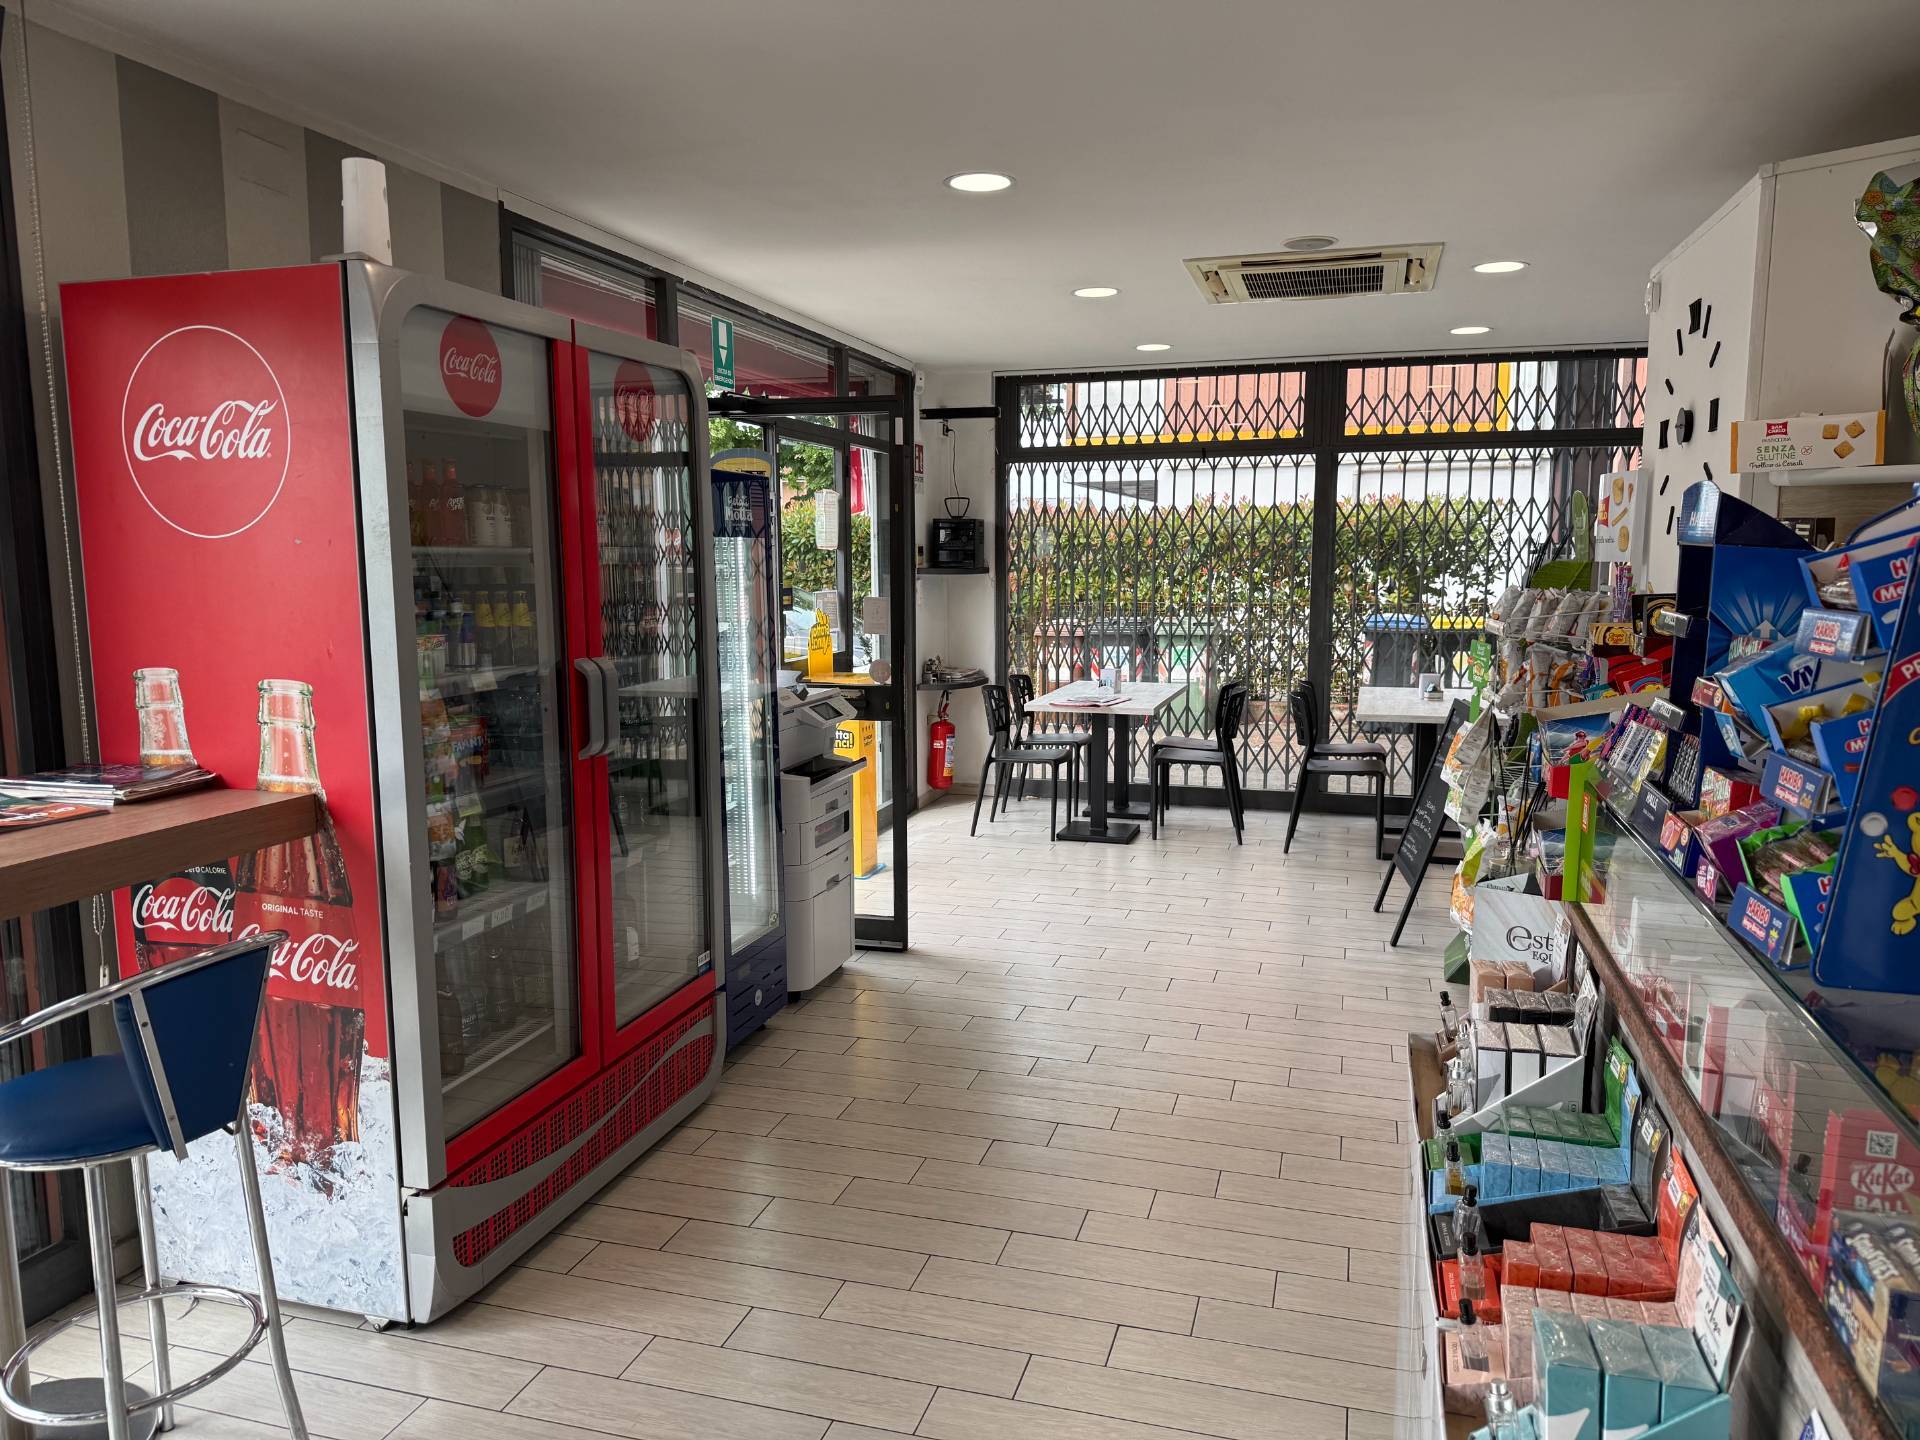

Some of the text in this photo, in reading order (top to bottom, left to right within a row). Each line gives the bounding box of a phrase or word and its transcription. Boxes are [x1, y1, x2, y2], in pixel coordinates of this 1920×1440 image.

[444, 347, 498, 384] Coca-Cola
[133, 399, 278, 462] Coca-Cola
[1756, 444, 1796, 454] SENZA
[1756, 452, 1796, 462] GLUTINE
[1779, 764, 1804, 793] HARIBO
[200, 866, 227, 875] CALORIE
[132, 884, 236, 933] Coca-Cola
[261, 902, 324, 919] ORIGINAL TASTE
[1746, 896, 1771, 927] HARIBO
[1856, 1164, 1911, 1193] KitKat
[1854, 1195, 1910, 1216] BALL
